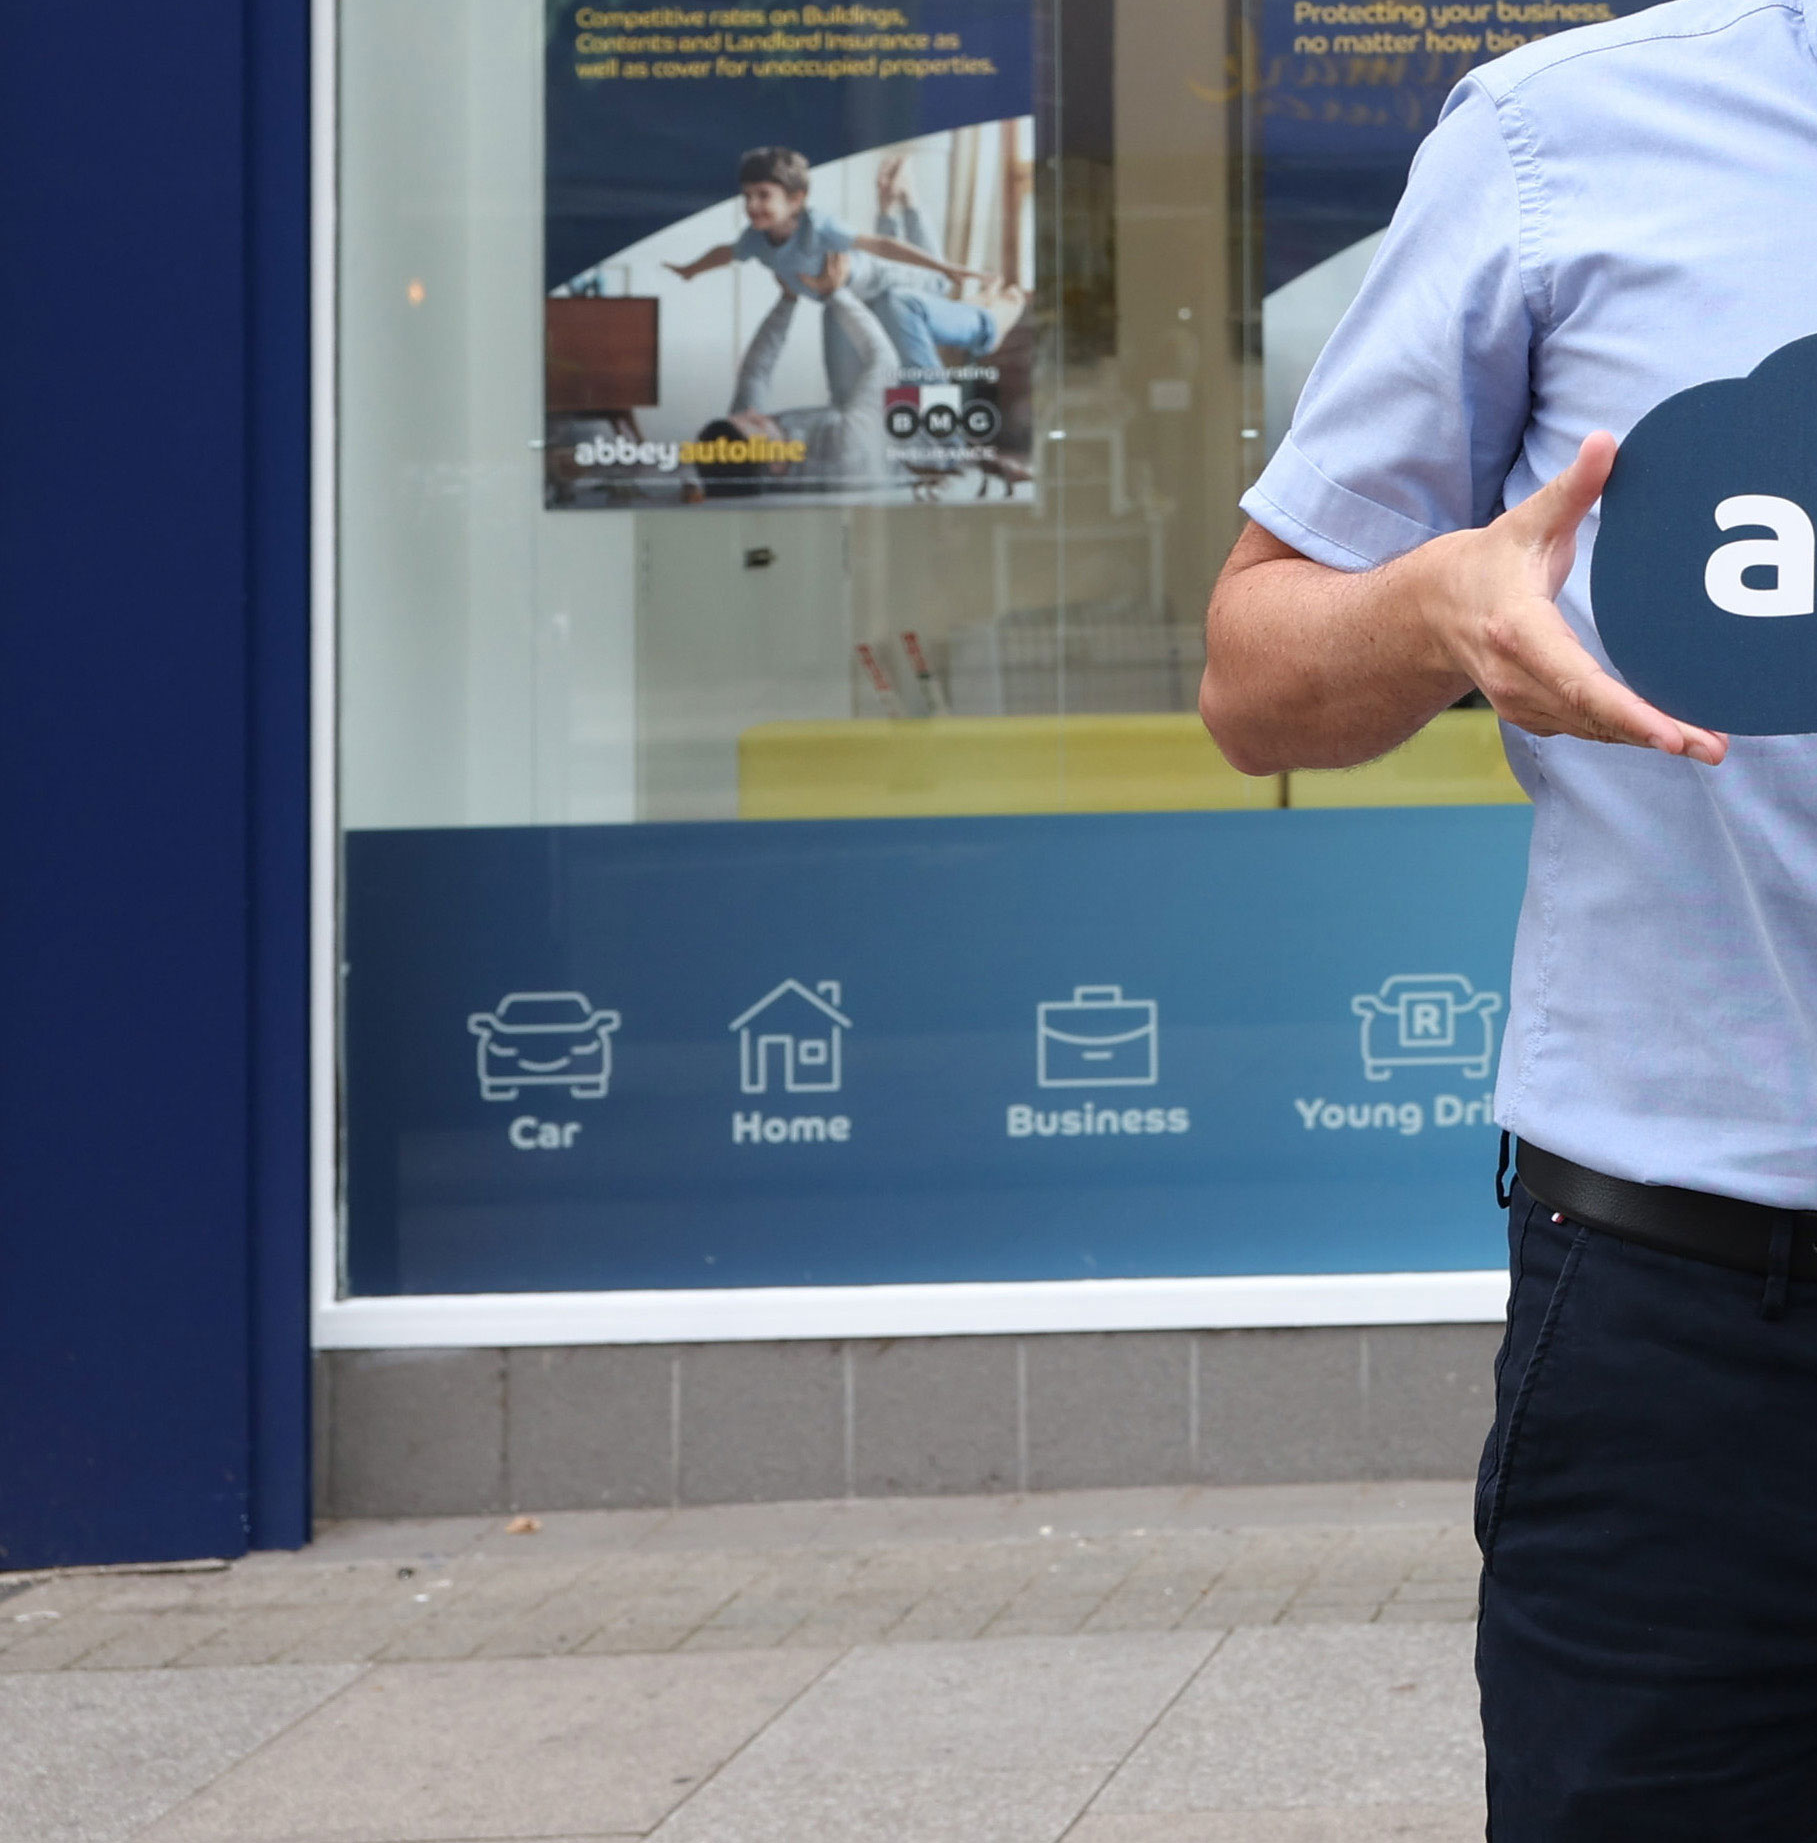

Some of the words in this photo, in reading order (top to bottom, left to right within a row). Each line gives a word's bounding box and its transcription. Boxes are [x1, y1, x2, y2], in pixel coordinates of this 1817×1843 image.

[575, 7, 706, 30] Competitive
[709, 9, 767, 27] rates
[769, 11, 799, 27] on
[803, 5, 908, 29] Buildings,
[1294, 1, 1427, 27] Protecting
[1430, 5, 1492, 29] your
[575, 33, 677, 53] Contents
[679, 32, 721, 52] and
[725, 31, 821, 52] Landlord
[826, 31, 929, 50] Insurance
[933, 34, 960, 49] as
[1294, 34, 1329, 54] no
[1333, 32, 1421, 54] matter
[1425, 29, 1481, 52] how
[575, 59, 616, 79] well
[622, 62, 648, 78] as
[651, 62, 711, 78] cover
[716, 57, 749, 77] for
[753, 57, 876, 79] unoccupied
[879, 57, 997, 79] properties.
[1413, 1004, 1438, 1036] R
[732, 1109, 851, 1145] Home
[1006, 1101, 1189, 1136] Business
[1294, 1096, 1422, 1133] Young
[509, 1115, 581, 1150] Car
